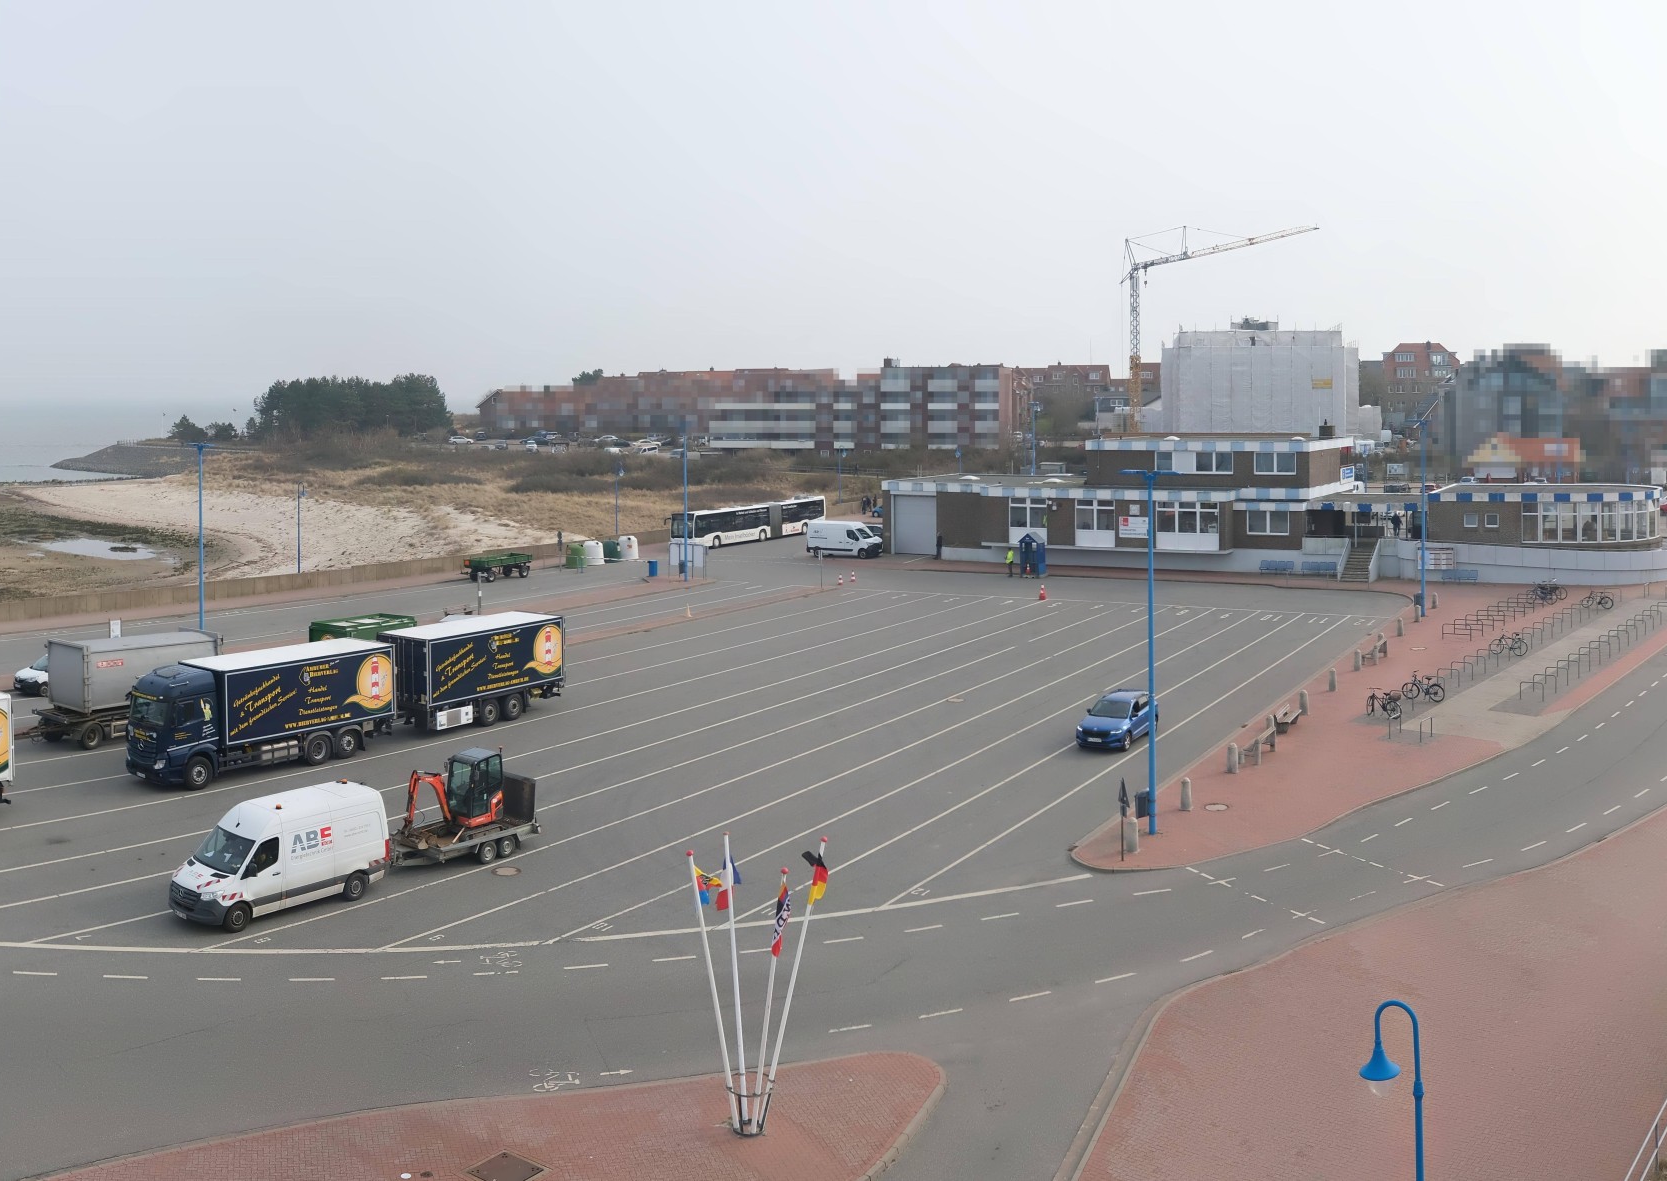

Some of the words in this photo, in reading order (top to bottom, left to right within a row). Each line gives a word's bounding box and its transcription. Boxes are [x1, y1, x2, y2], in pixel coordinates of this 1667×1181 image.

[245, 686, 281, 712] Transport
[291, 826, 331, 854] ABE
[911, 887, 931, 896] 12
[592, 921, 614, 932] 10
